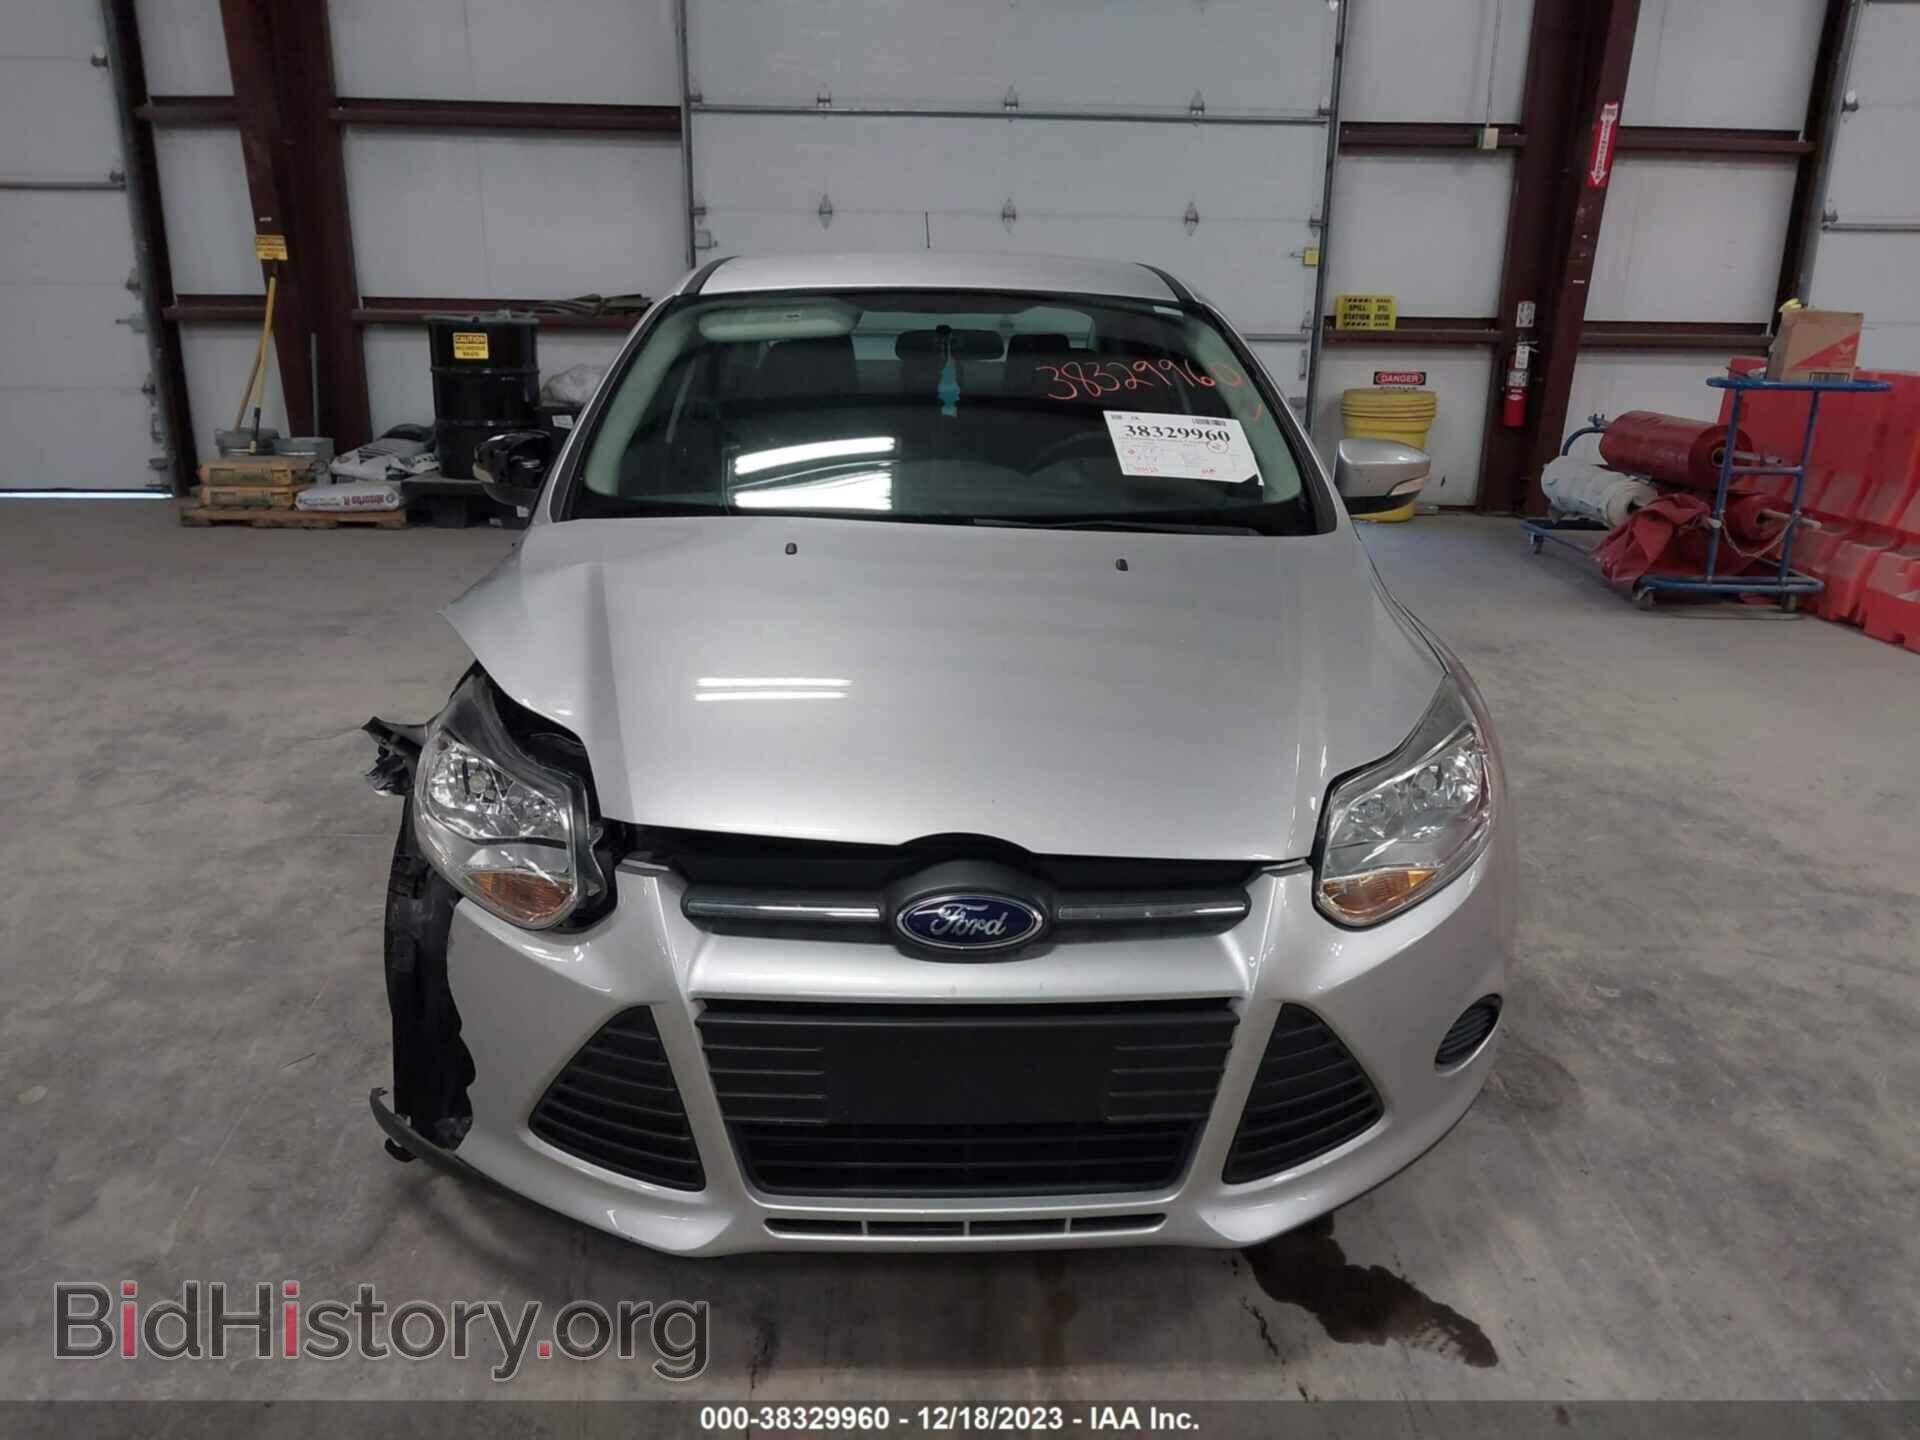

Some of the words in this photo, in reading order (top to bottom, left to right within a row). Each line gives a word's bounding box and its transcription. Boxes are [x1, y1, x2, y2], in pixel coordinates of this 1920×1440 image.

[455, 336, 486, 344] CAUTION
[1035, 359, 1244, 401] 38329960
[1380, 374, 1418, 383] DANGER
[1124, 423, 1231, 443] 38329960
[914, 903, 1008, 936] Ford
